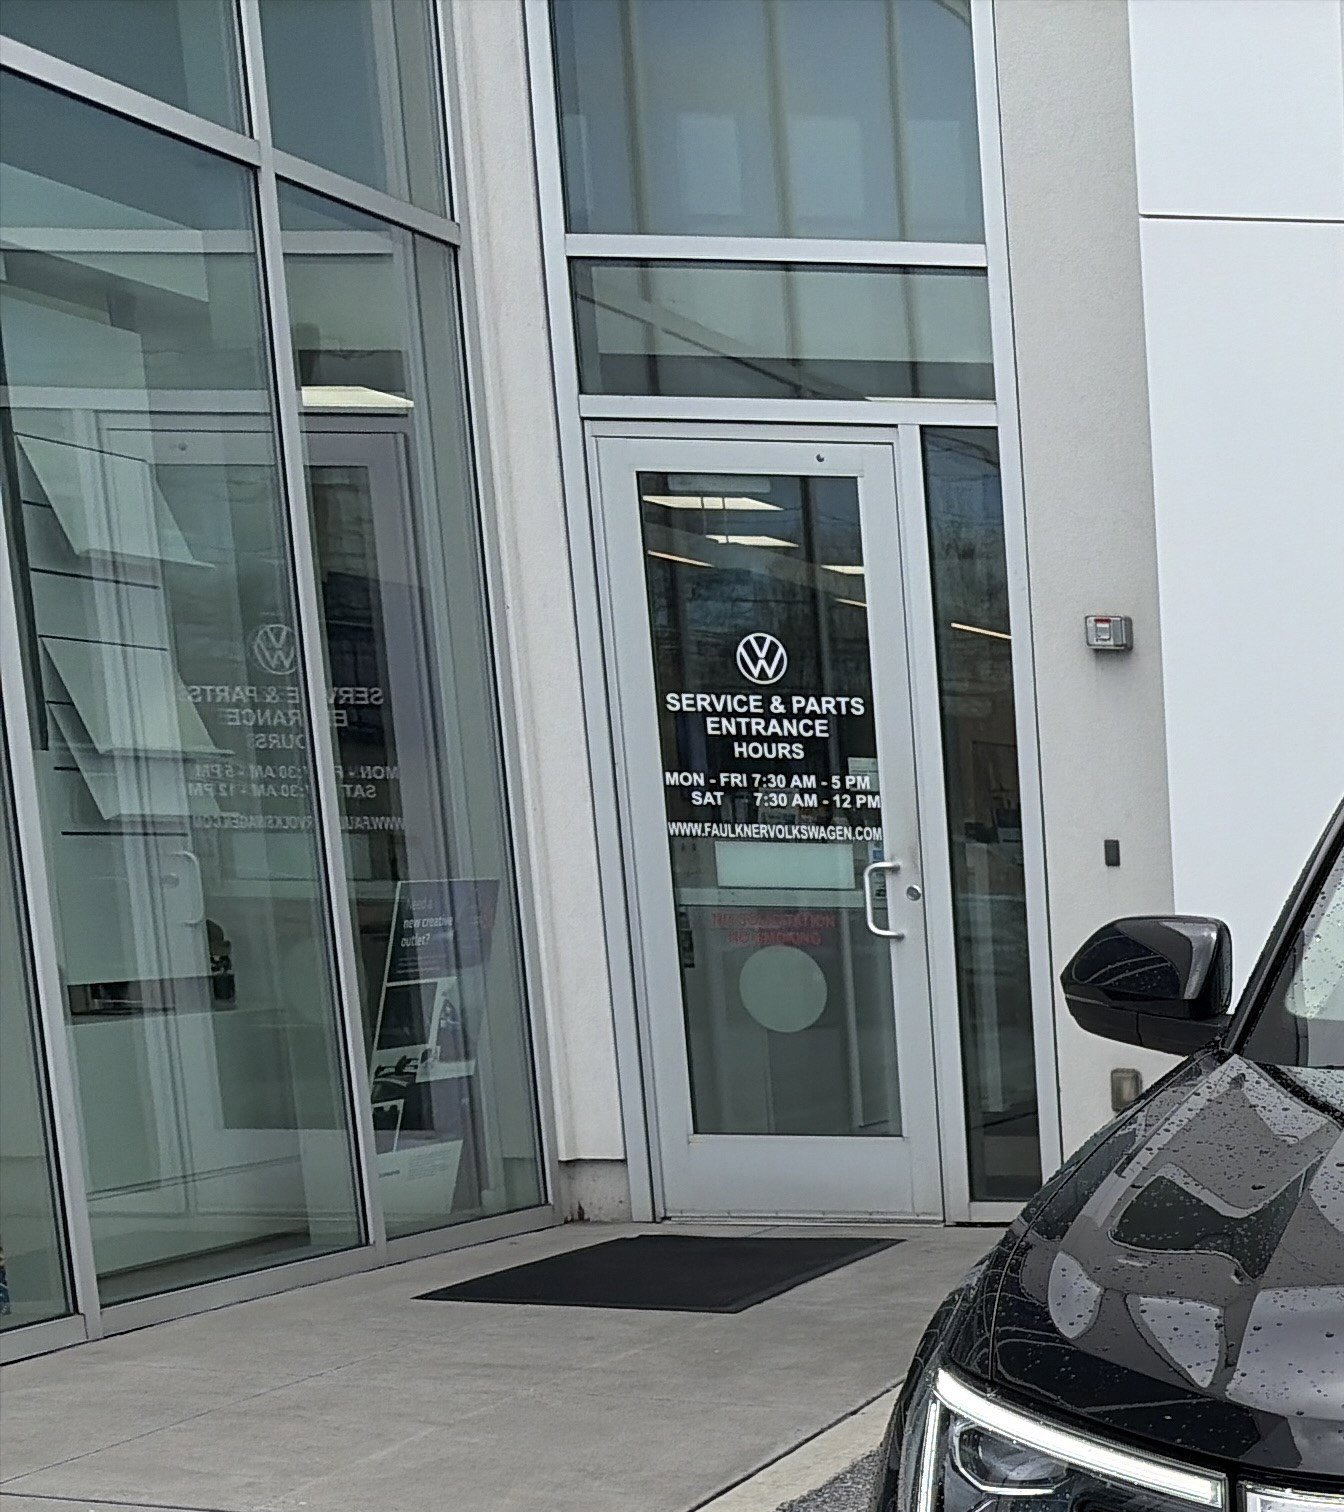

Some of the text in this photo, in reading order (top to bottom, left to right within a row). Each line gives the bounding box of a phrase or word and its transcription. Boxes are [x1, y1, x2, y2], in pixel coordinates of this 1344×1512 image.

[665, 692, 865, 716] SERVICE & PARTS
[706, 716, 830, 738] ENTRANCE
[733, 741, 805, 760] HOURS
[665, 770, 705, 787] MON
[719, 772, 748, 788] FRI
[751, 773, 787, 789] 7:30
[790, 774, 817, 789] AM
[831, 775, 841, 790] 5
[845, 775, 871, 790] PM
[691, 791, 725, 806] SAT
[753, 792, 788, 807] 7:30
[791, 793, 819, 808] AM
[832, 793, 852, 809] 12
[855, 794, 882, 809] PM
[667, 821, 883, 841] WWW.FAULKNERVOLKSWAGEN.COM
[403, 918, 419, 929] new
[400, 933, 431, 947] outlet?
